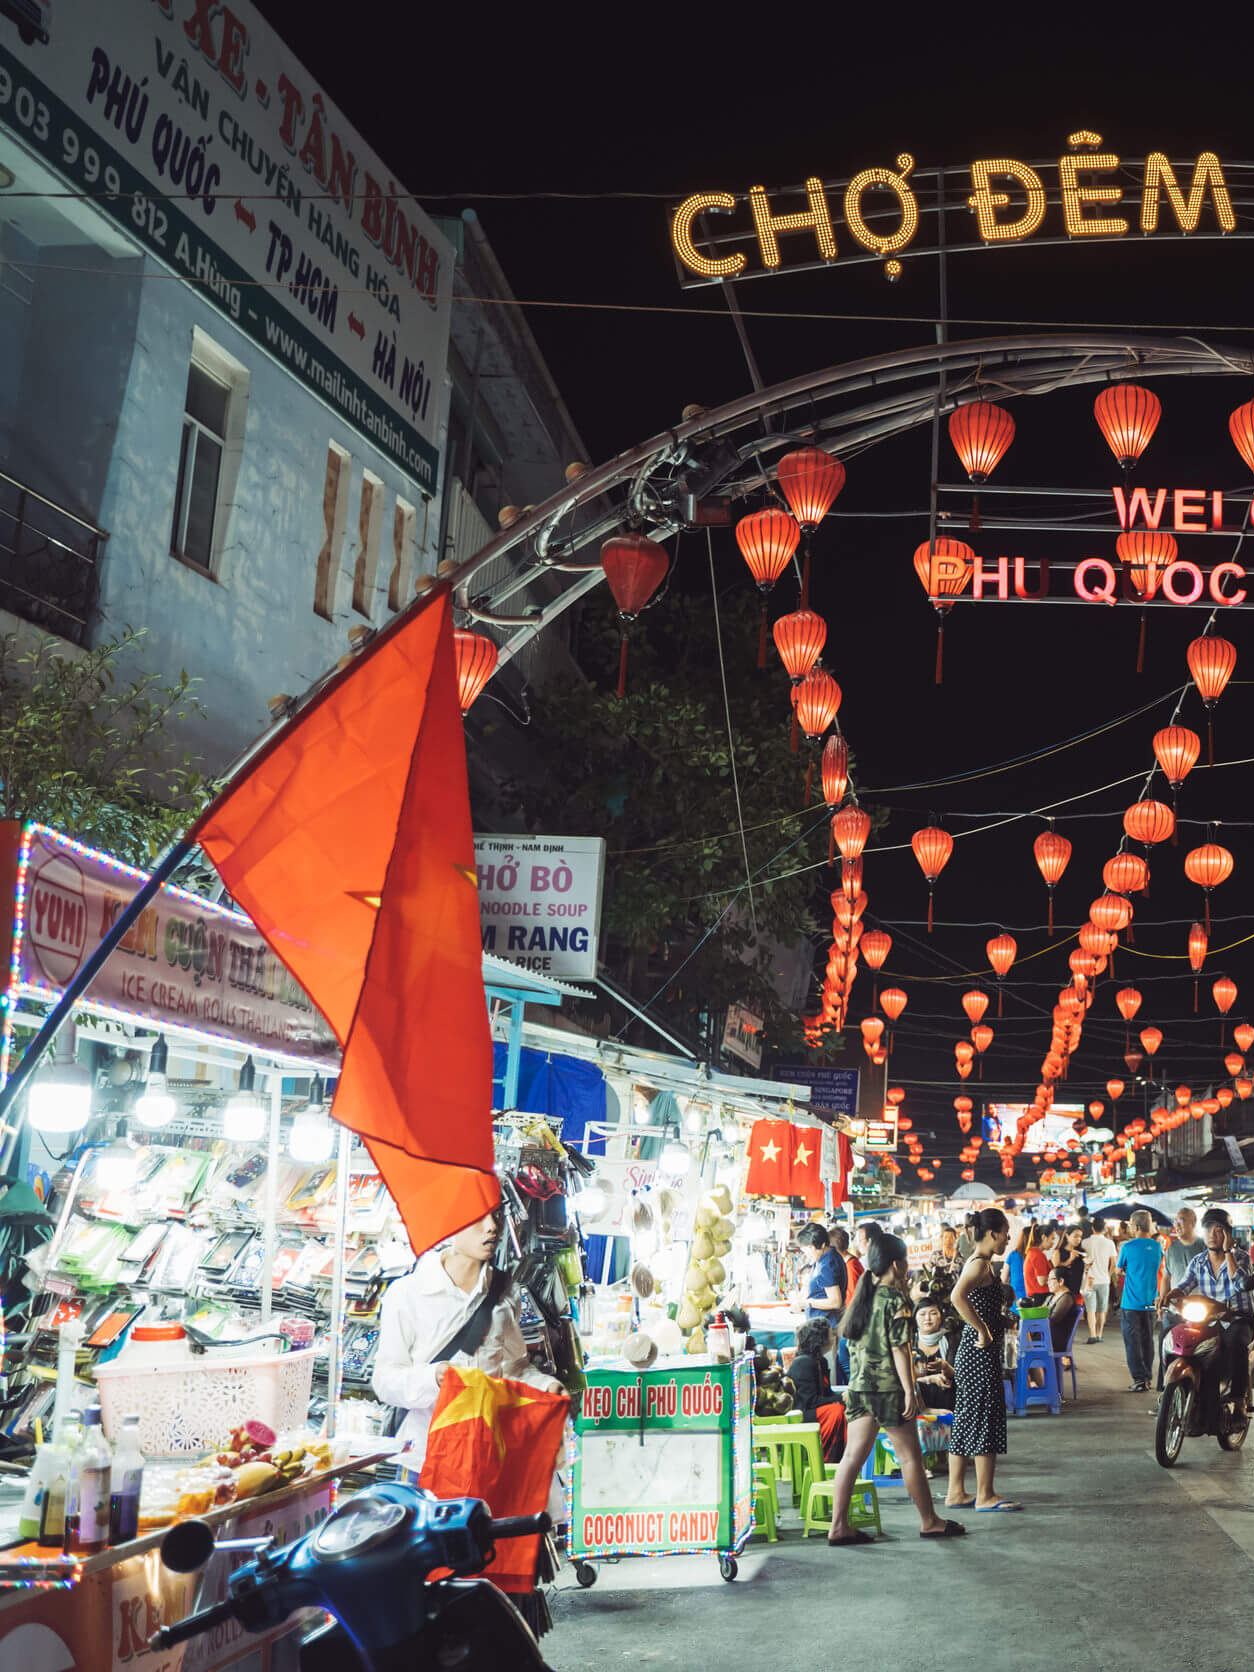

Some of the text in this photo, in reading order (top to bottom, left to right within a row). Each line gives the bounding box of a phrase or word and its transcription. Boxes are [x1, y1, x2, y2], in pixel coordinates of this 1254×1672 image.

[156, 37, 401, 325] VẬN CHUYỂN HÀNG HÓA
[278, 72, 358, 217] TÂN
[361, 171, 439, 308] BÌNH
[672, 153, 919, 278] CHỢ
[967, 130, 1236, 242] ĐÊM
[87, 47, 431, 422] PHÚ QUỐC TP.HCM HÀ NỘI
[63, 128, 120, 200] 999
[131, 190, 169, 250] 812
[175, 232, 241, 318] A.Hùng
[265, 315, 432, 483] www.mailinhtanbinh.com
[930, 554, 1050, 600] PHU
[1073, 557, 1247, 606] QUOC
[477, 854, 573, 893] HỞ BÒ
[522, 843, 542, 851] NAM
[34, 888, 83, 949] YUMI
[480, 902, 588, 917] NOODLE SOUP
[507, 926, 589, 952] RANG
[515, 956, 552, 971] RICE
[121, 971, 145, 1003] ICE
[151, 981, 198, 1017] CREAM
[203, 996, 236, 1027] ROLLS
[583, 1384, 612, 1425] KẸO
[647, 1379, 677, 1417] PHÚ
[682, 1372, 723, 1417] QUỐC
[584, 1510, 719, 1547] COCONUCT CANDY
